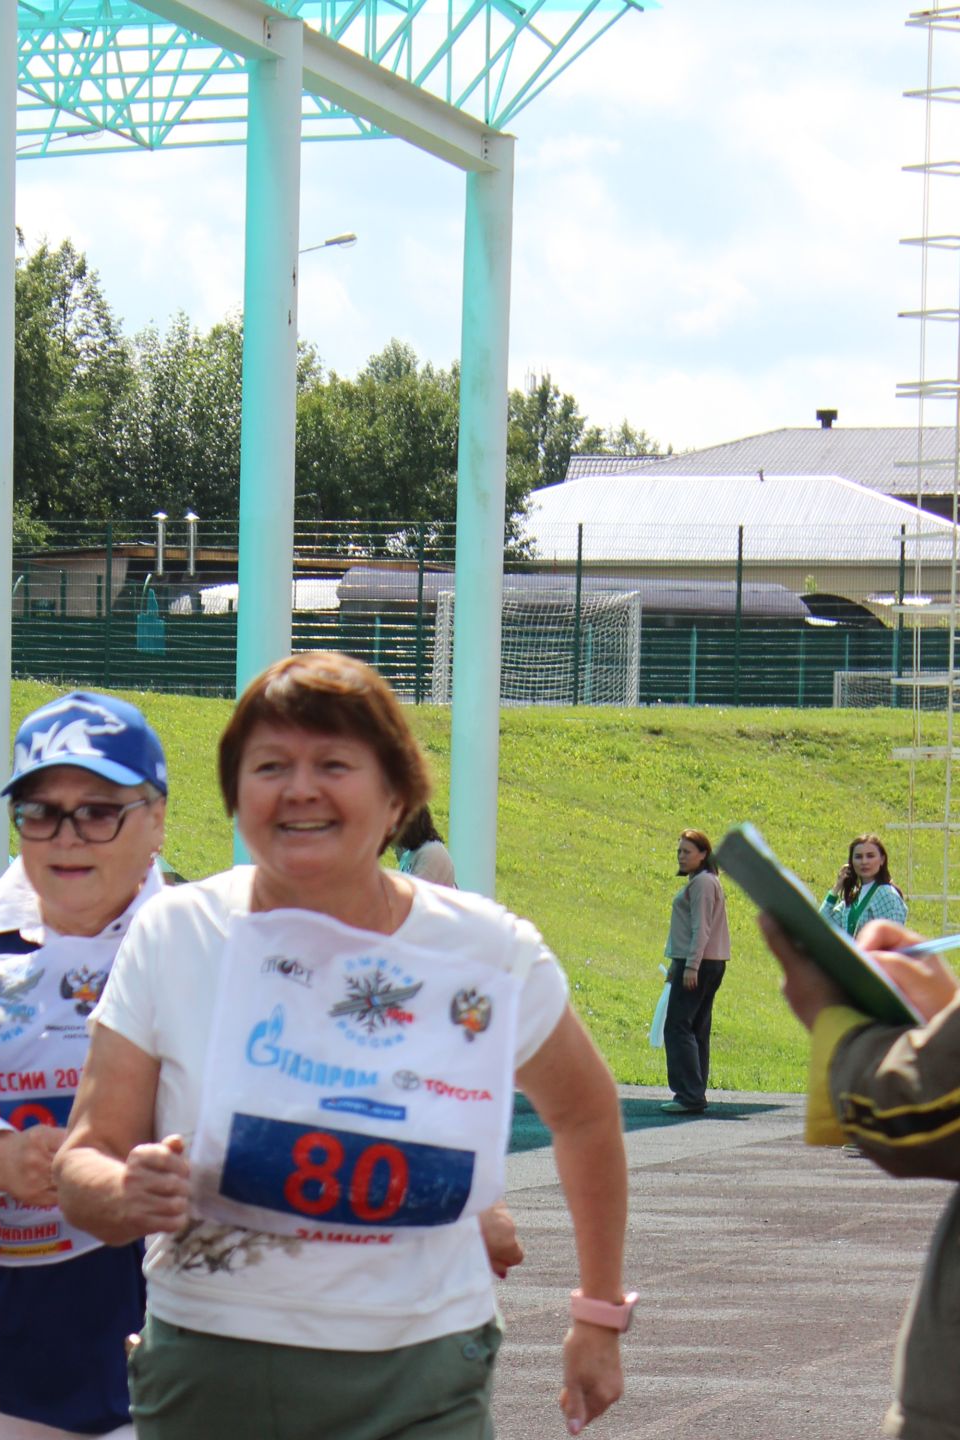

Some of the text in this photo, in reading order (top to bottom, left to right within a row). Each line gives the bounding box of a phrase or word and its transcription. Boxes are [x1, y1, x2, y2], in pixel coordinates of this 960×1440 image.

[55, 1067, 85, 1089] 20
[424, 1077, 493, 1102] TOYOTA
[284, 1132, 409, 1222] 80
